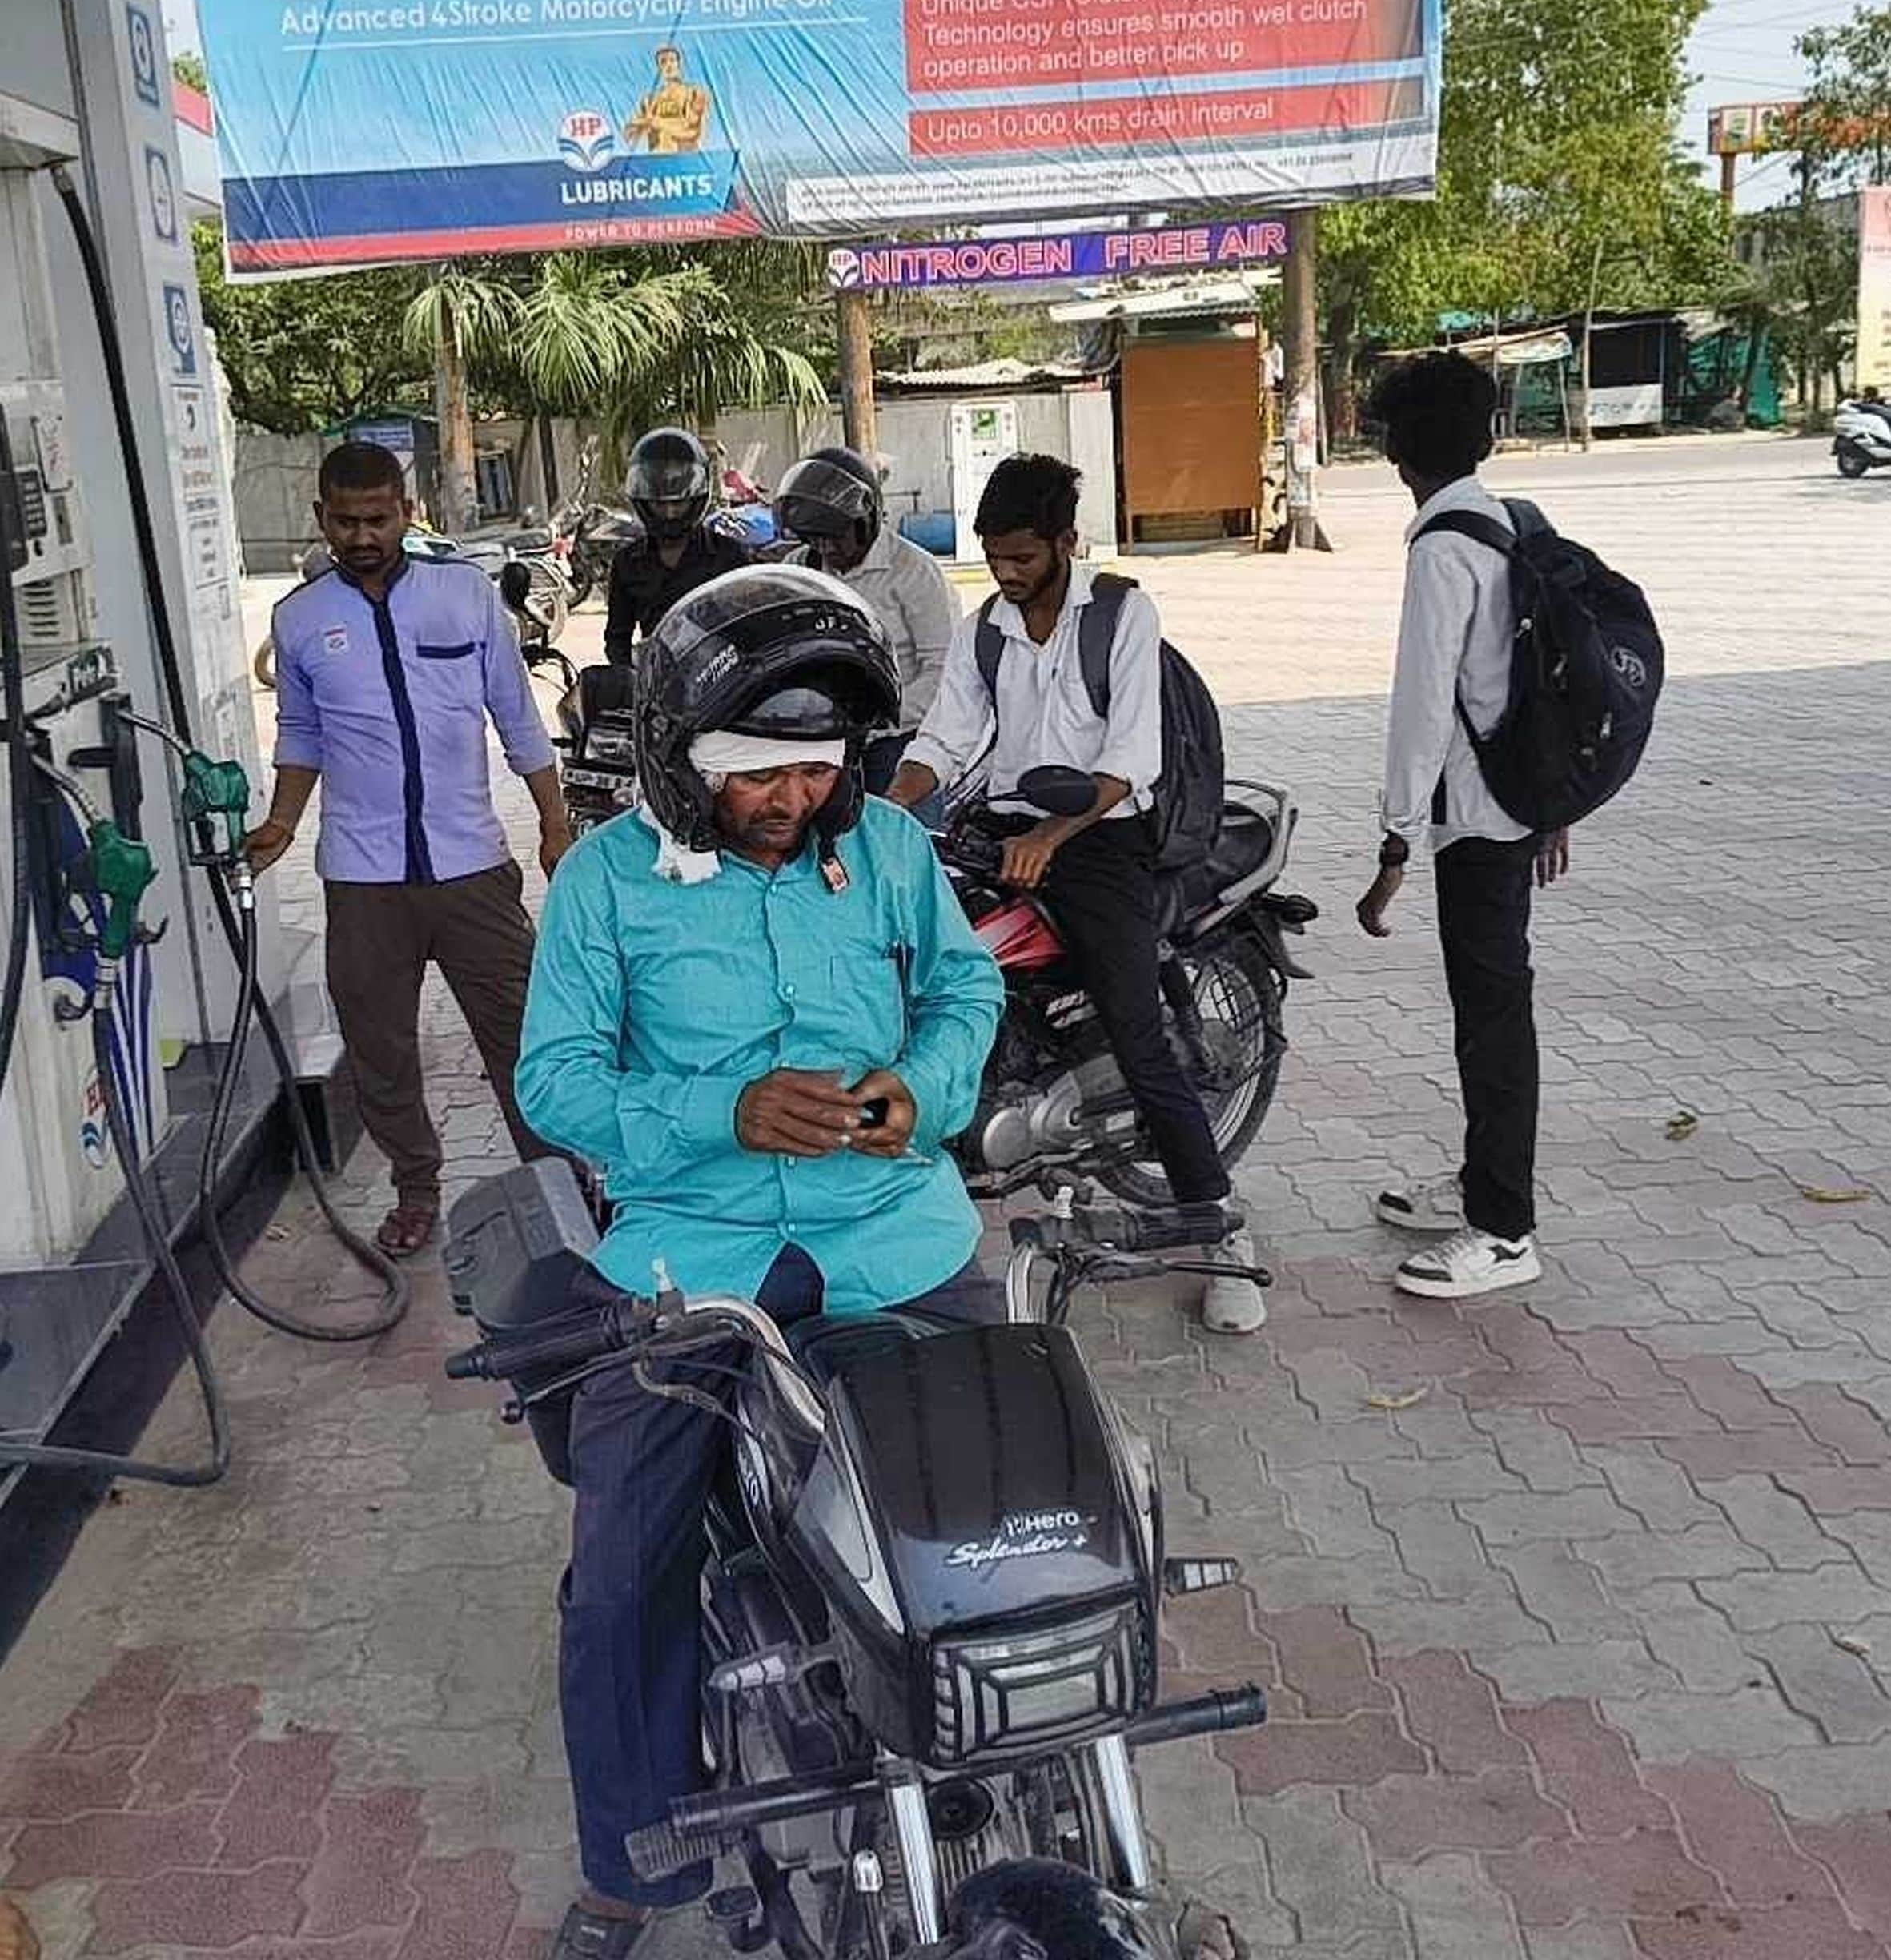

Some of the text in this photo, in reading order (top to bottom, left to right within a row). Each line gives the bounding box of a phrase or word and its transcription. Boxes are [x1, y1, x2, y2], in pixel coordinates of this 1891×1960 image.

[281, 4, 425, 34] Advanced
[431, 0, 532, 28] 4Stroke
[541, 0, 688, 22] Motorcycle
[922, 0, 1367, 46] Technology ensures smooth wet clutch
[925, 38, 1243, 79] operation and better pick up
[570, 118, 601, 137] HP
[928, 118, 982, 145] Upto
[990, 110, 1066, 139] 10,000
[1074, 111, 1121, 134] kms
[1127, 104, 1185, 128] drain
[561, 174, 712, 205] LUBRICANTS
[862, 222, 1287, 284] NITROGEN FREE AIR
[1026, 1512, 1080, 1531] Hero
